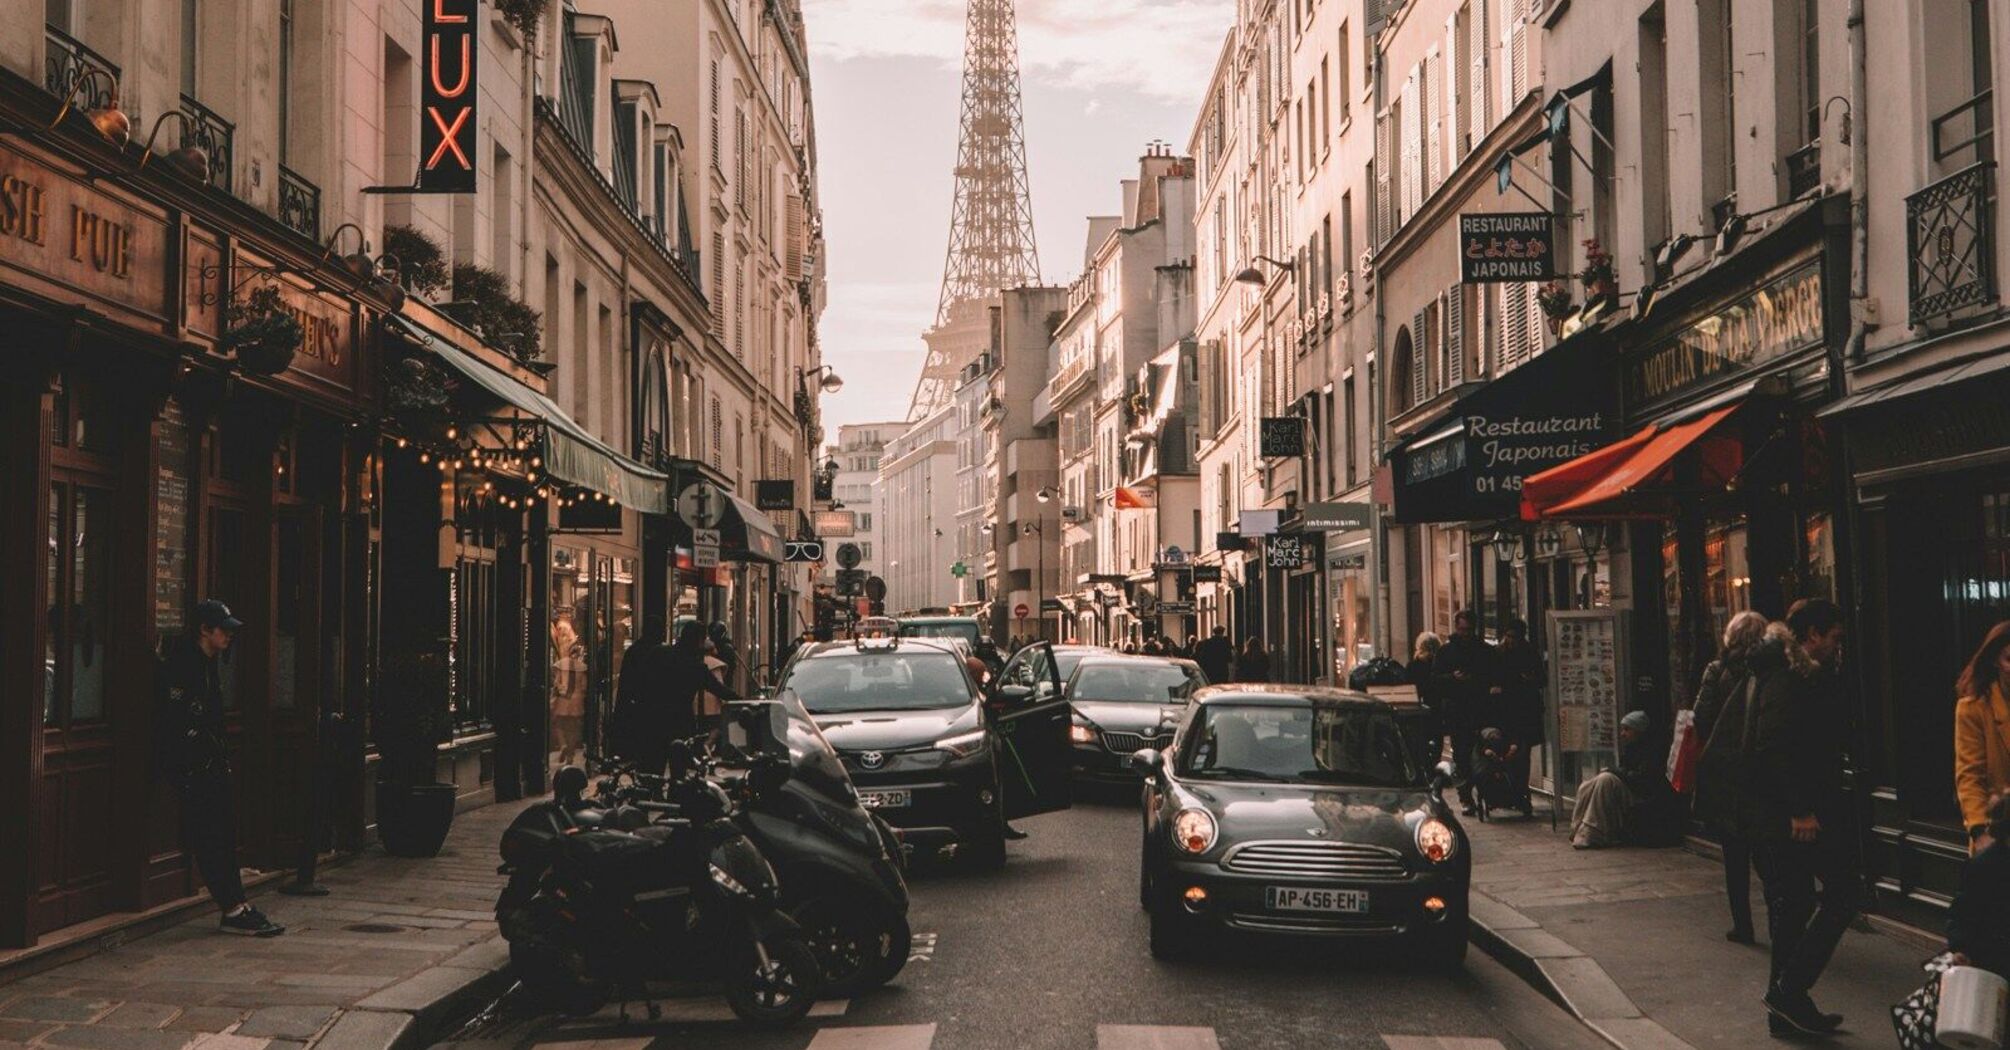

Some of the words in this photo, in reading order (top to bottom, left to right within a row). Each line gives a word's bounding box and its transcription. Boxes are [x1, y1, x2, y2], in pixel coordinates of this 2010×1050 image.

[1463, 216, 1548, 233] RESTAURANT
[1466, 237, 1547, 259] とよたか
[1472, 261, 1543, 278] JAPONAIS
[1643, 341, 1696, 397] MOULIN
[1726, 310, 1753, 363] LA
[1269, 421, 1300, 434] Karl
[1467, 412, 1602, 438] Restaurant
[1263, 432, 1300, 444] Marc
[1264, 442, 1300, 454] John
[1482, 439, 1591, 468] Japonais
[1475, 477, 1495, 493] 01
[1501, 475, 1522, 492] 45
[1307, 519, 1360, 527] intimissimi
[1273, 536, 1300, 549] Karl
[1268, 547, 1300, 558] Marc
[1268, 555, 1300, 567] John
[1278, 889, 1357, 909] AP-456-EH
